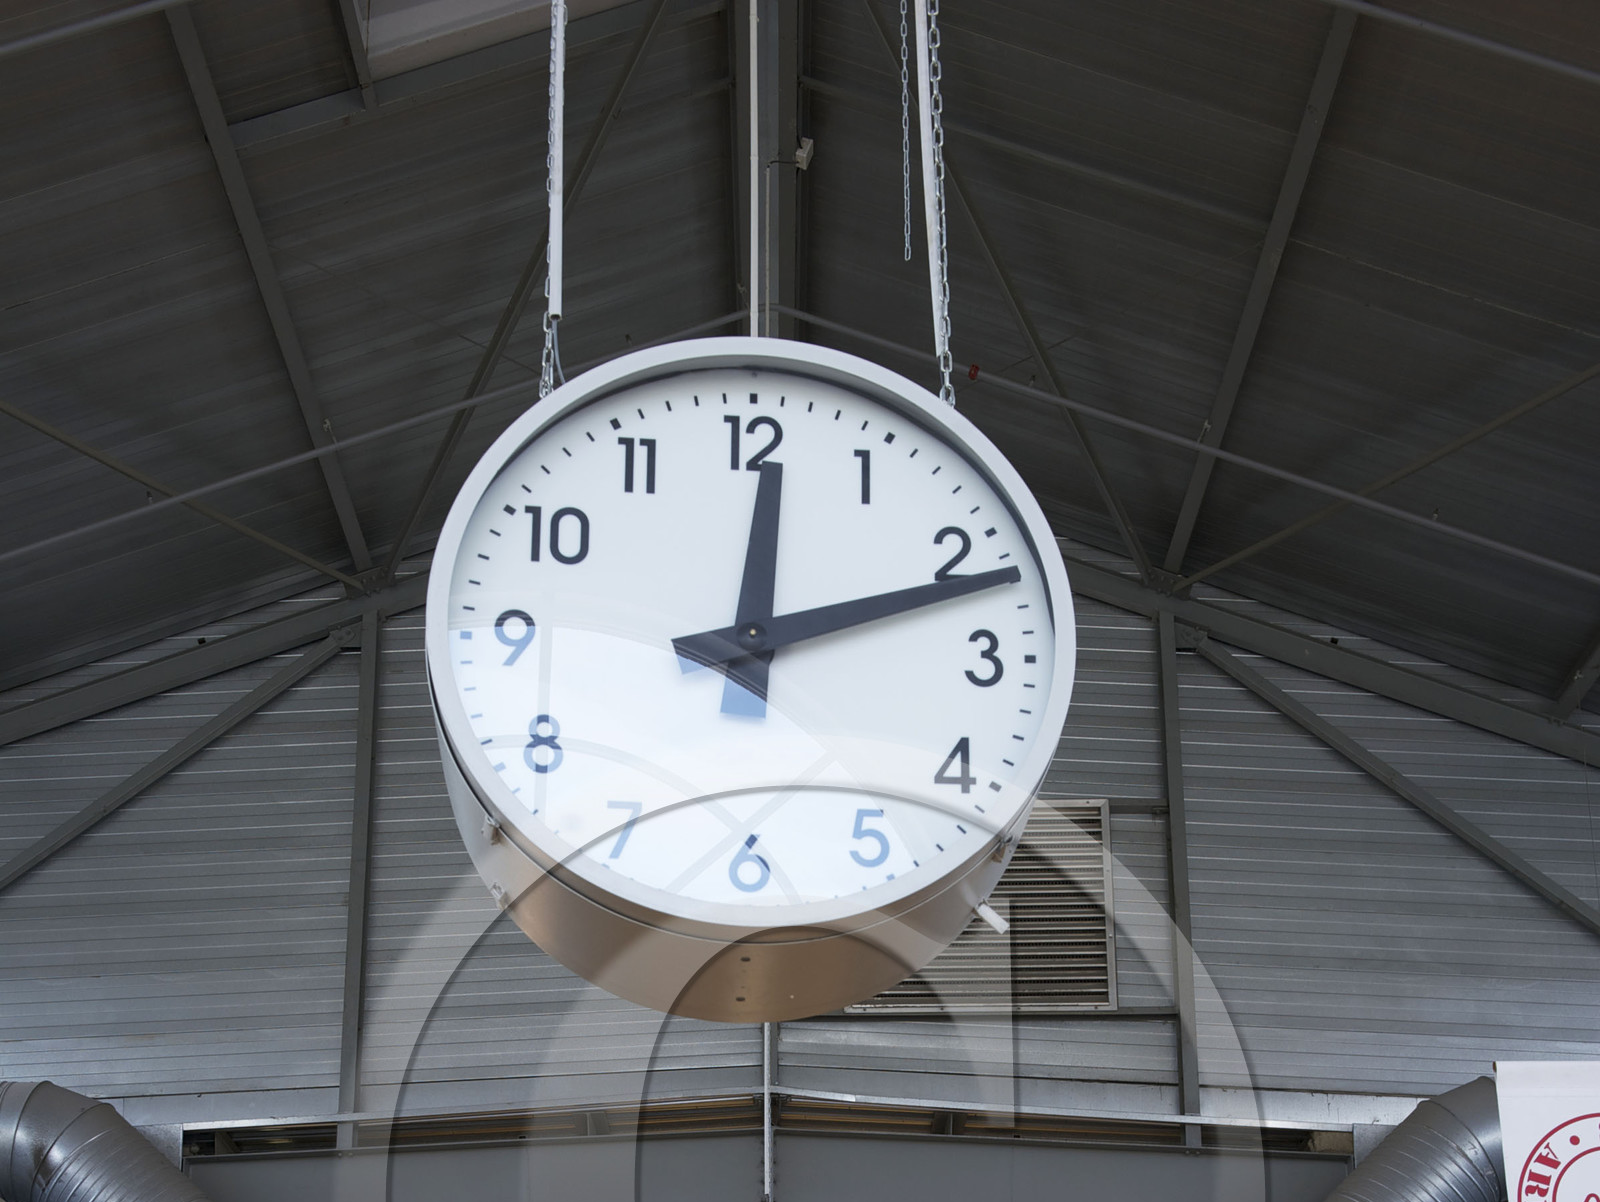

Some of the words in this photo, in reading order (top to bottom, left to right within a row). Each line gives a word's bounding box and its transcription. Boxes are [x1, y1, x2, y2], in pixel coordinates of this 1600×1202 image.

[617, 437, 656, 494] 11
[723, 415, 783, 471] 12
[854, 449, 870, 505] 1
[523, 504, 590, 565] 10
[932, 526, 973, 581] 2
[494, 609, 536, 666] 9
[964, 629, 1004, 688] 3
[523, 714, 564, 774] 8
[933, 737, 977, 794] 4
[606, 800, 643, 860] 7
[848, 808, 891, 868] 5
[727, 833, 771, 894] 6
